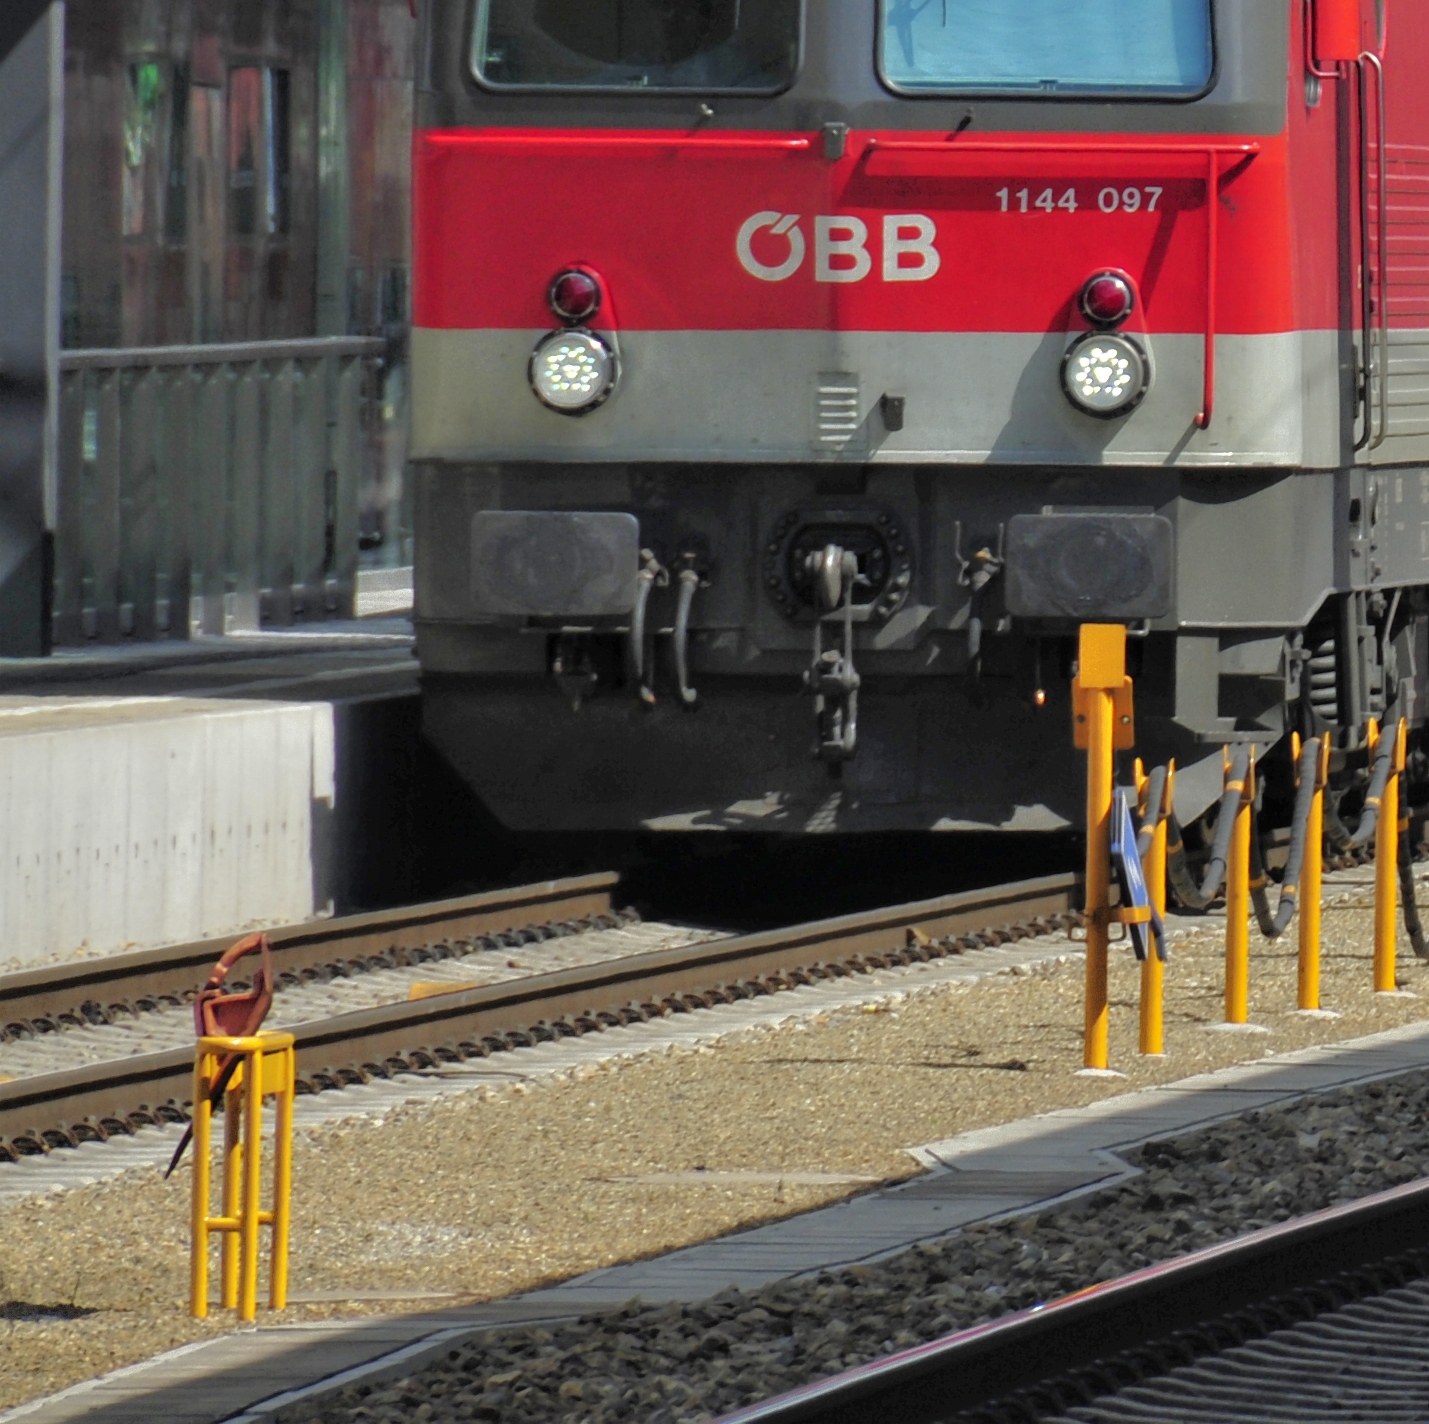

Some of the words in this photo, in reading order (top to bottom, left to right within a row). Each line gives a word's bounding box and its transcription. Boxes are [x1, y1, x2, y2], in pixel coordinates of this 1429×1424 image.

[996, 187, 1078, 213] 1144
[1097, 186, 1164, 213] 097
[736, 210, 941, 283] ÖBB
